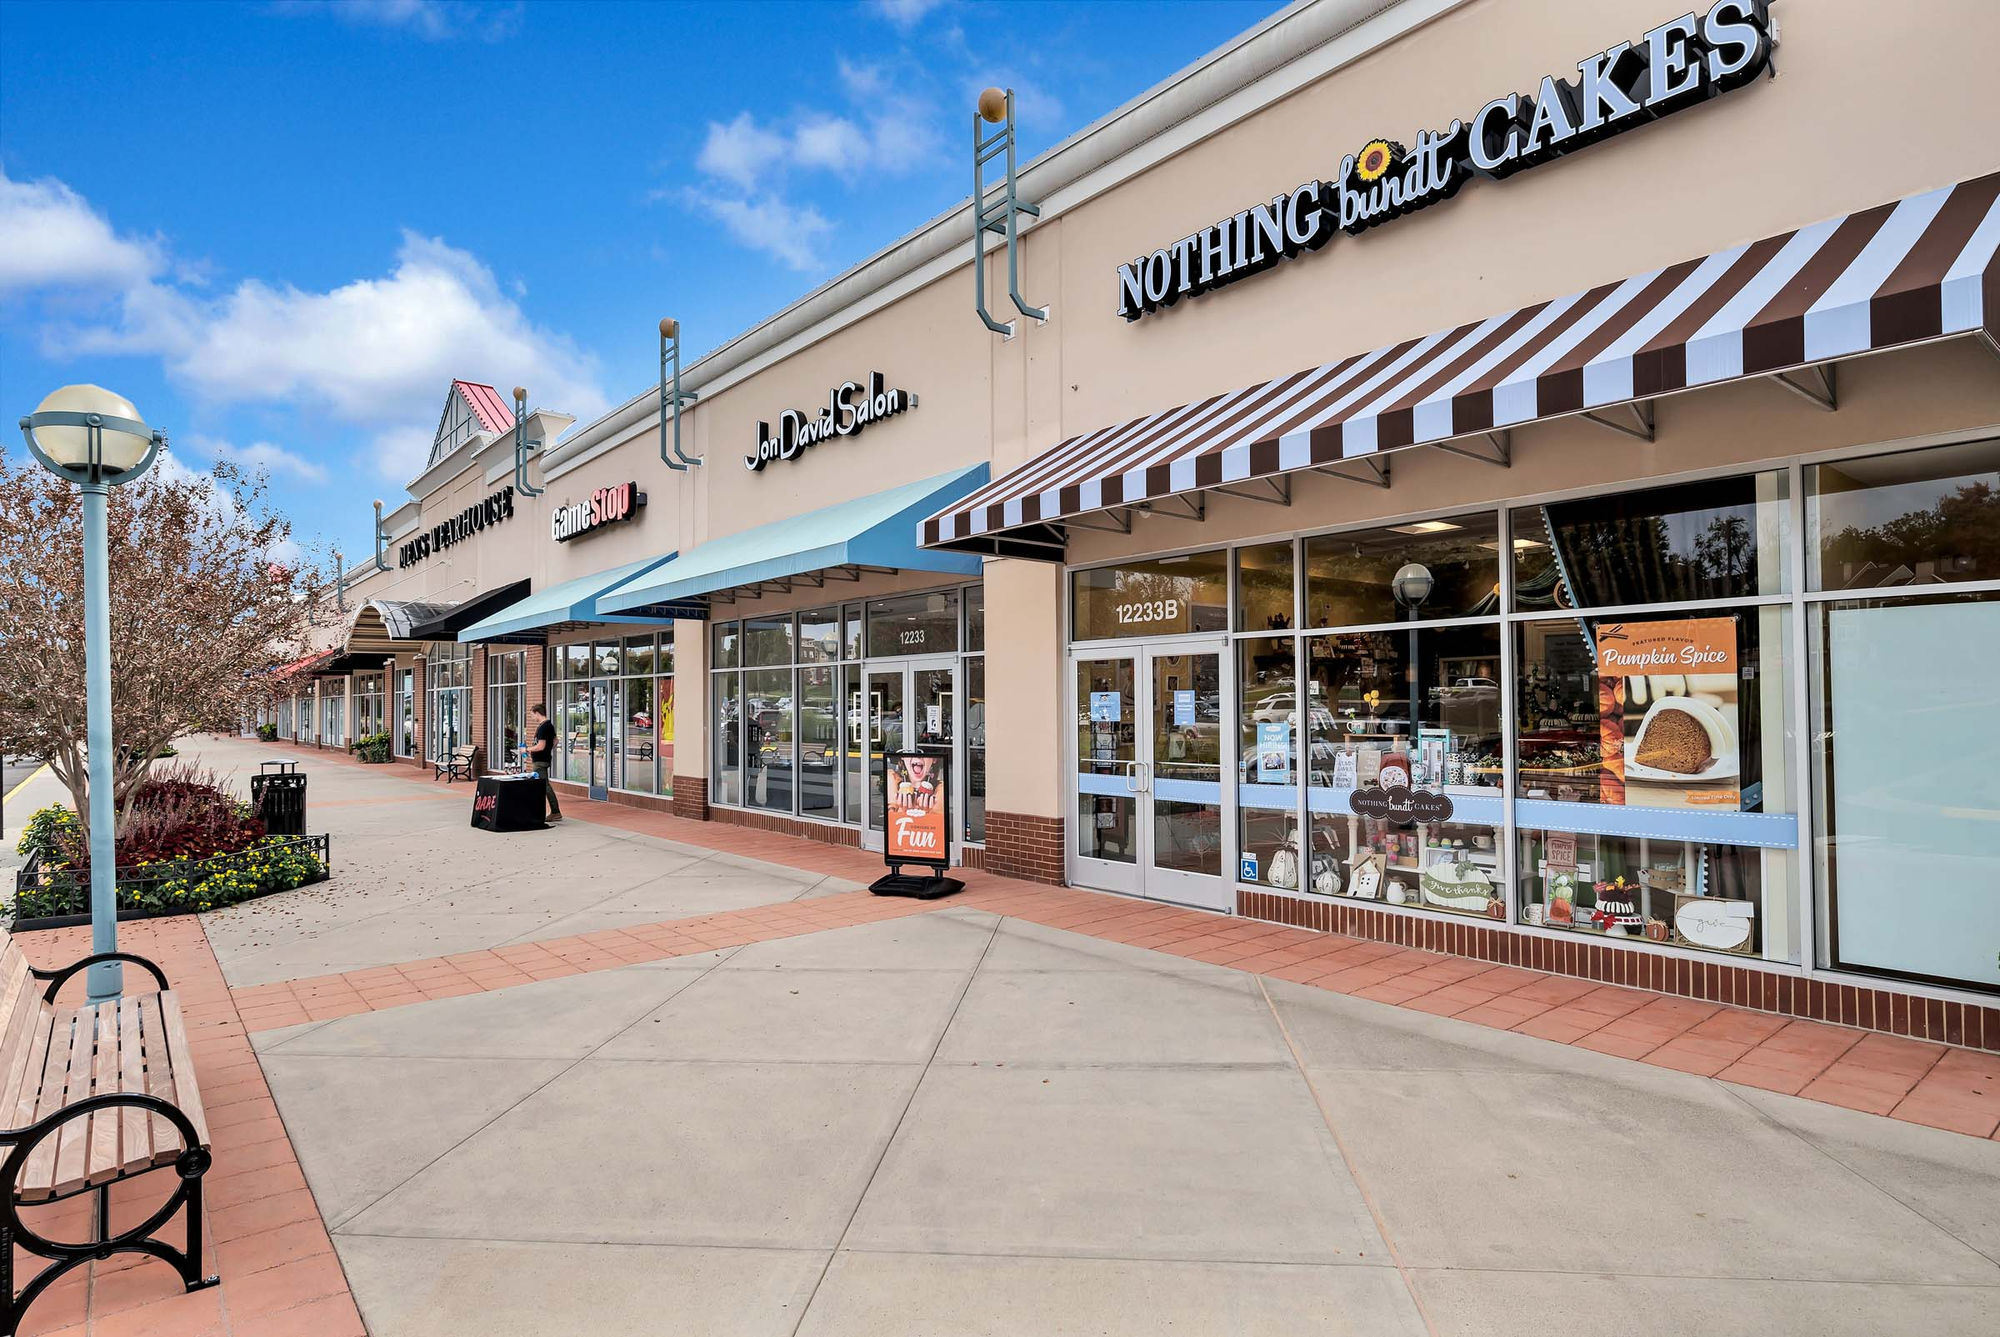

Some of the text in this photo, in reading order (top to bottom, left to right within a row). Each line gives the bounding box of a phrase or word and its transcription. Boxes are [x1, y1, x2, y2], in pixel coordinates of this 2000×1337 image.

[1117, 0, 1759, 317] NOTHING bundt CAKES
[551, 482, 630, 542] GameStop
[1115, 599, 1178, 624] 12233B
[900, 629, 925, 645] 12233
[1632, 636, 1666, 646] FEATURED
[1602, 646, 1678, 670] Pumpkin
[1679, 644, 1728, 668] Spice
[1357, 799, 1388, 808] NOTHING
[1387, 795, 1415, 812] bundt
[895, 816, 936, 849] Fun
